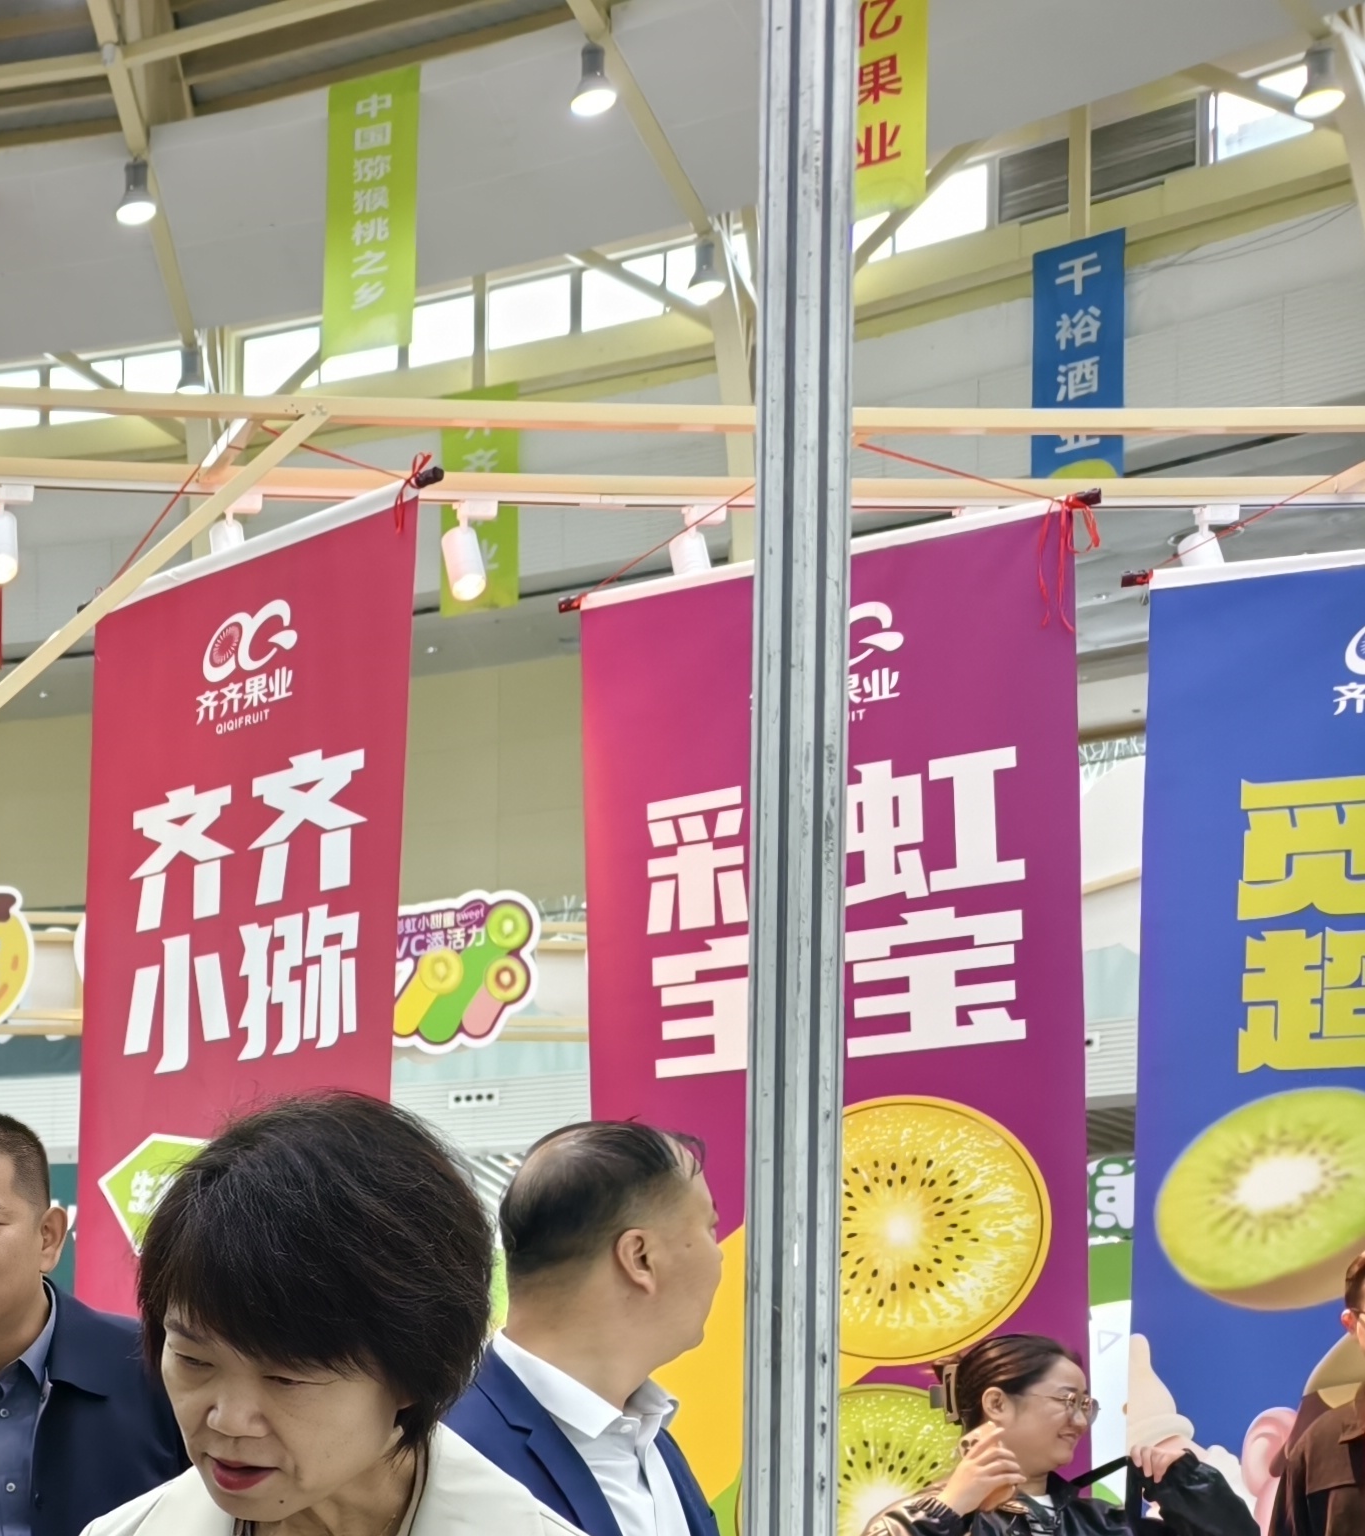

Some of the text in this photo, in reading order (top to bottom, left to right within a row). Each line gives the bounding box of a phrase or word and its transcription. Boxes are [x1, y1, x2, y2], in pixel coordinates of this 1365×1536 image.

[350, 93, 396, 312] 中国猕猴桃之乡
[195, 666, 293, 726] 齐齐果业
[215, 708, 270, 735] QIQIFRUIT
[130, 748, 368, 934] 齐齐
[121, 902, 360, 1076] 小猕
